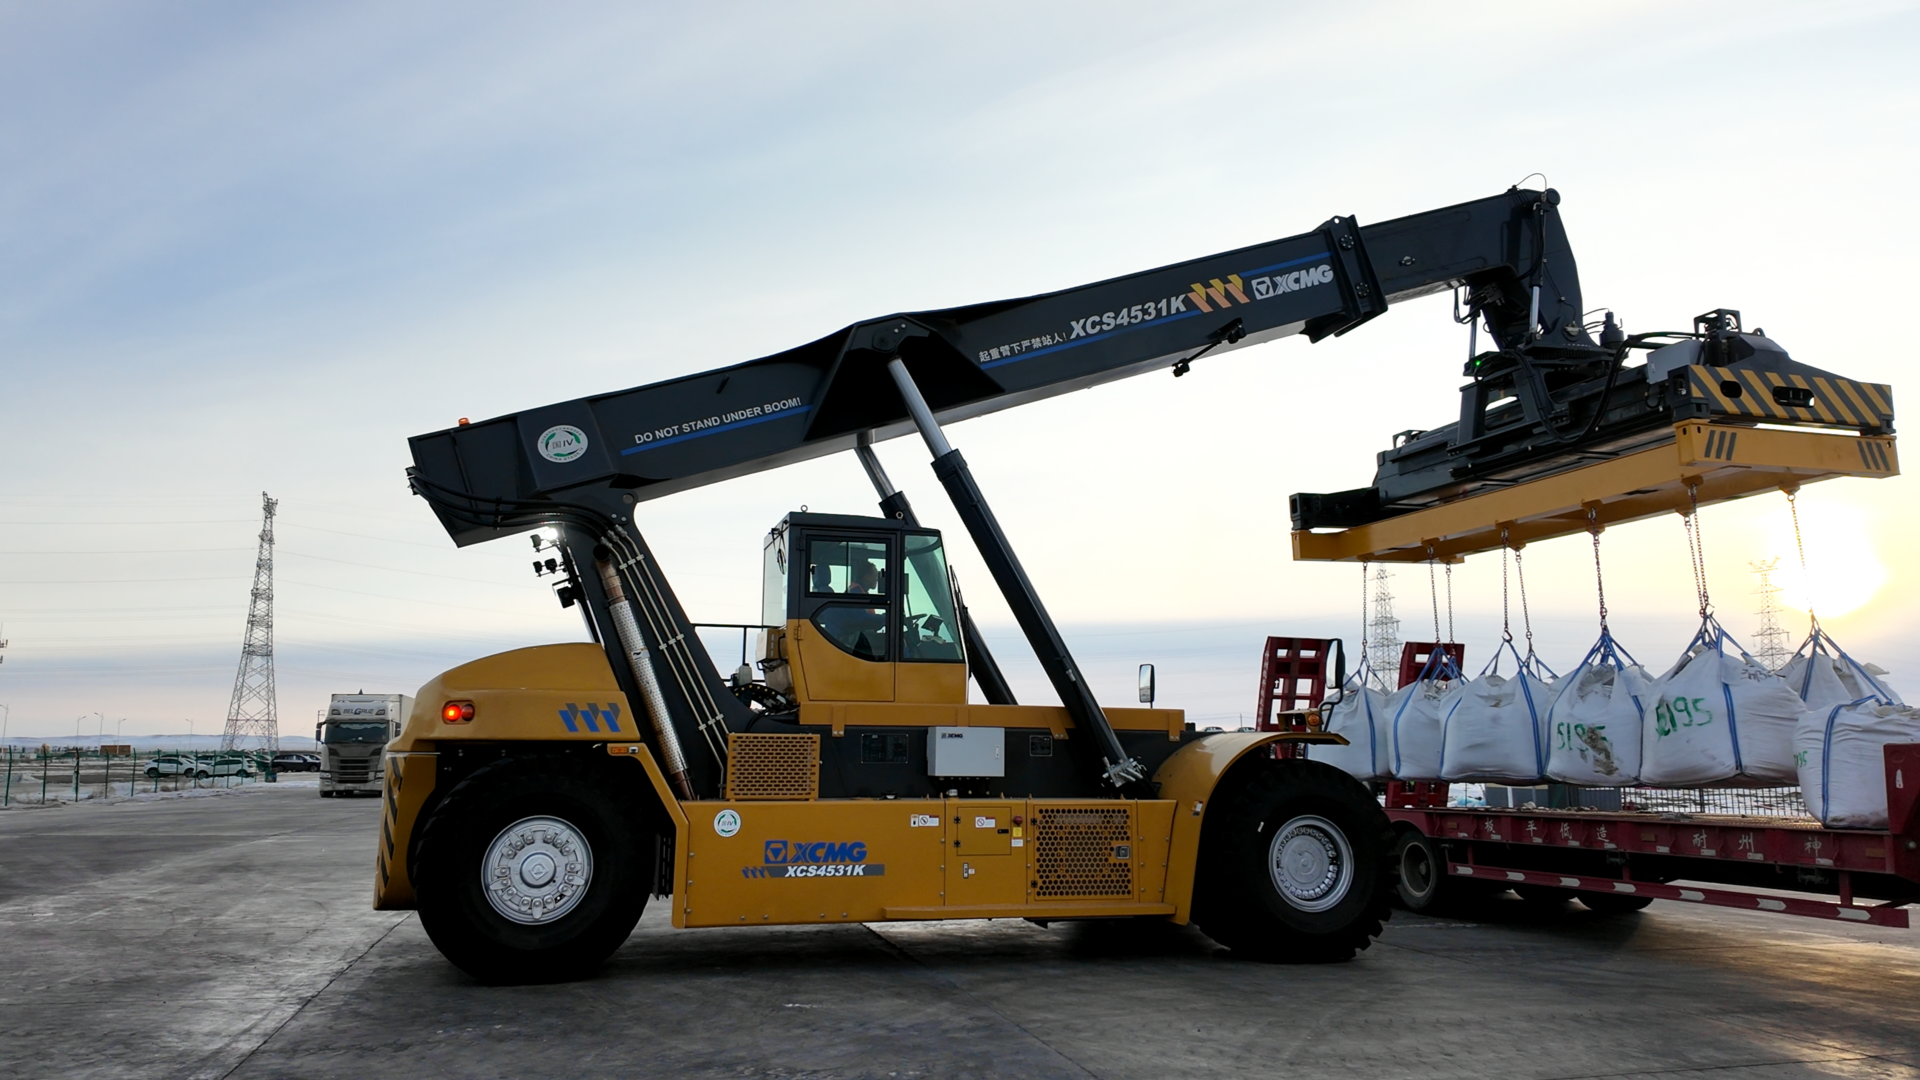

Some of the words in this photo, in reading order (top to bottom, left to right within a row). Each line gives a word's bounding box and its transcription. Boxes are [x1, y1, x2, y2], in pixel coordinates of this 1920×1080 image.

[1273, 263, 1334, 294] XCMG
[1069, 292, 1188, 339] XCS4531K
[634, 433, 653, 444] DO
[654, 425, 680, 440] NOT
[682, 416, 721, 433] STAND
[723, 406, 763, 424] UNDER
[764, 396, 802, 414] BOOM!
[788, 841, 868, 863] XCMG
[785, 864, 867, 878] XCS4531K
